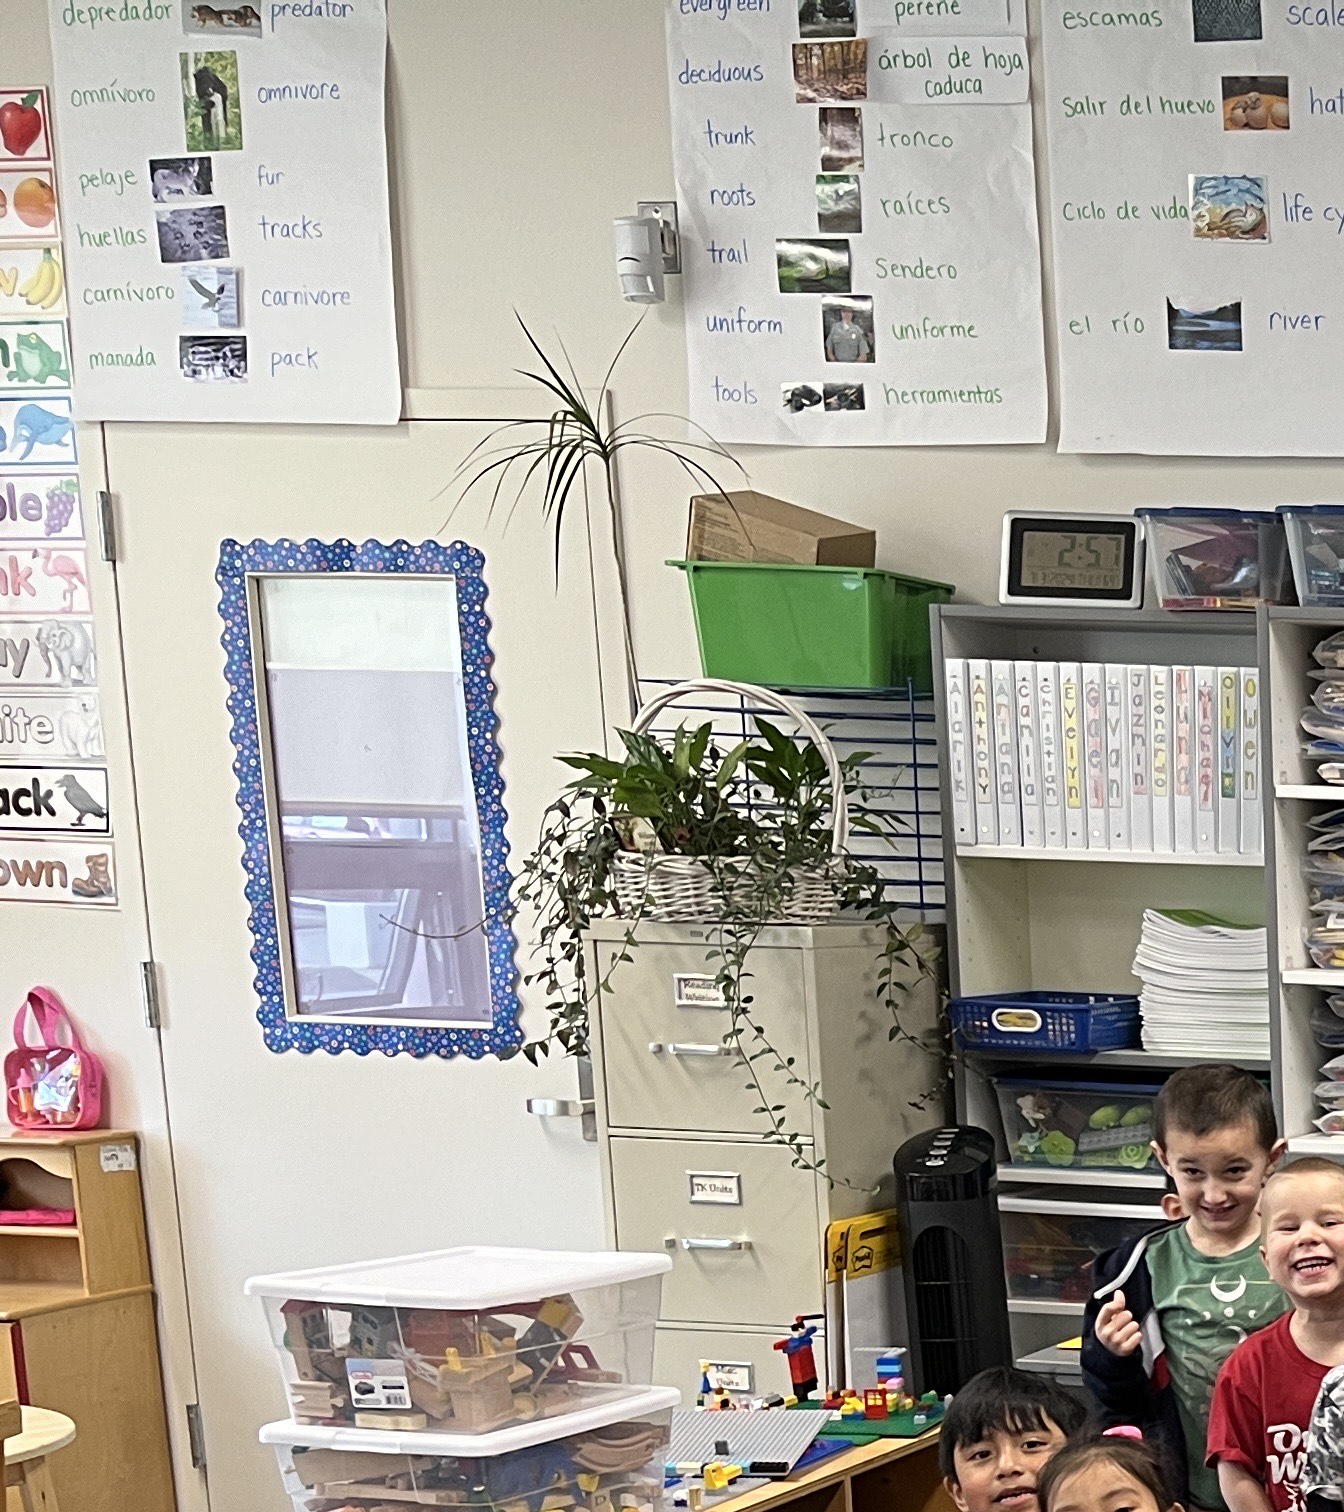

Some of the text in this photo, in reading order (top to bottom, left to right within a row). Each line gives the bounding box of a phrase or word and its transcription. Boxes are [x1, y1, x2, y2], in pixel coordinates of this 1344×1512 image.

[63, 1, 173, 29] depredador
[270, 0, 352, 32] predator
[1063, 9, 1163, 28] escamas
[678, 61, 764, 85] deciduous
[878, 47, 1023, 76] árbol de hoja
[71, 78, 155, 108] omnívoro
[258, 82, 341, 103] omnivore
[924, 77, 982, 97] caduca
[1120, 94, 1151, 115] del
[1161, 95, 1215, 115] huevo
[704, 119, 756, 147] trunk
[877, 123, 954, 149] tronco
[79, 168, 138, 196] pelaje
[257, 165, 284, 187] fur
[710, 183, 756, 206] roots
[880, 189, 950, 219] raíces
[1117, 200, 1140, 220] de
[1151, 195, 1189, 220] vida
[1283, 193, 1313, 222] life
[77, 224, 147, 248] huellas
[259, 215, 323, 240] tracks
[707, 239, 749, 264] trail
[83, 282, 175, 306] carnívoro
[261, 287, 351, 308] carnivore
[706, 308, 783, 334] uniform
[892, 318, 979, 341] uniforme
[1069, 311, 1145, 335] el río
[1269, 313, 1326, 331] river
[89, 346, 156, 369] manada
[271, 347, 319, 377] pack
[712, 376, 758, 405] tools
[883, 383, 1003, 405] herramientas
[1058, 535, 1121, 568] 2:57
